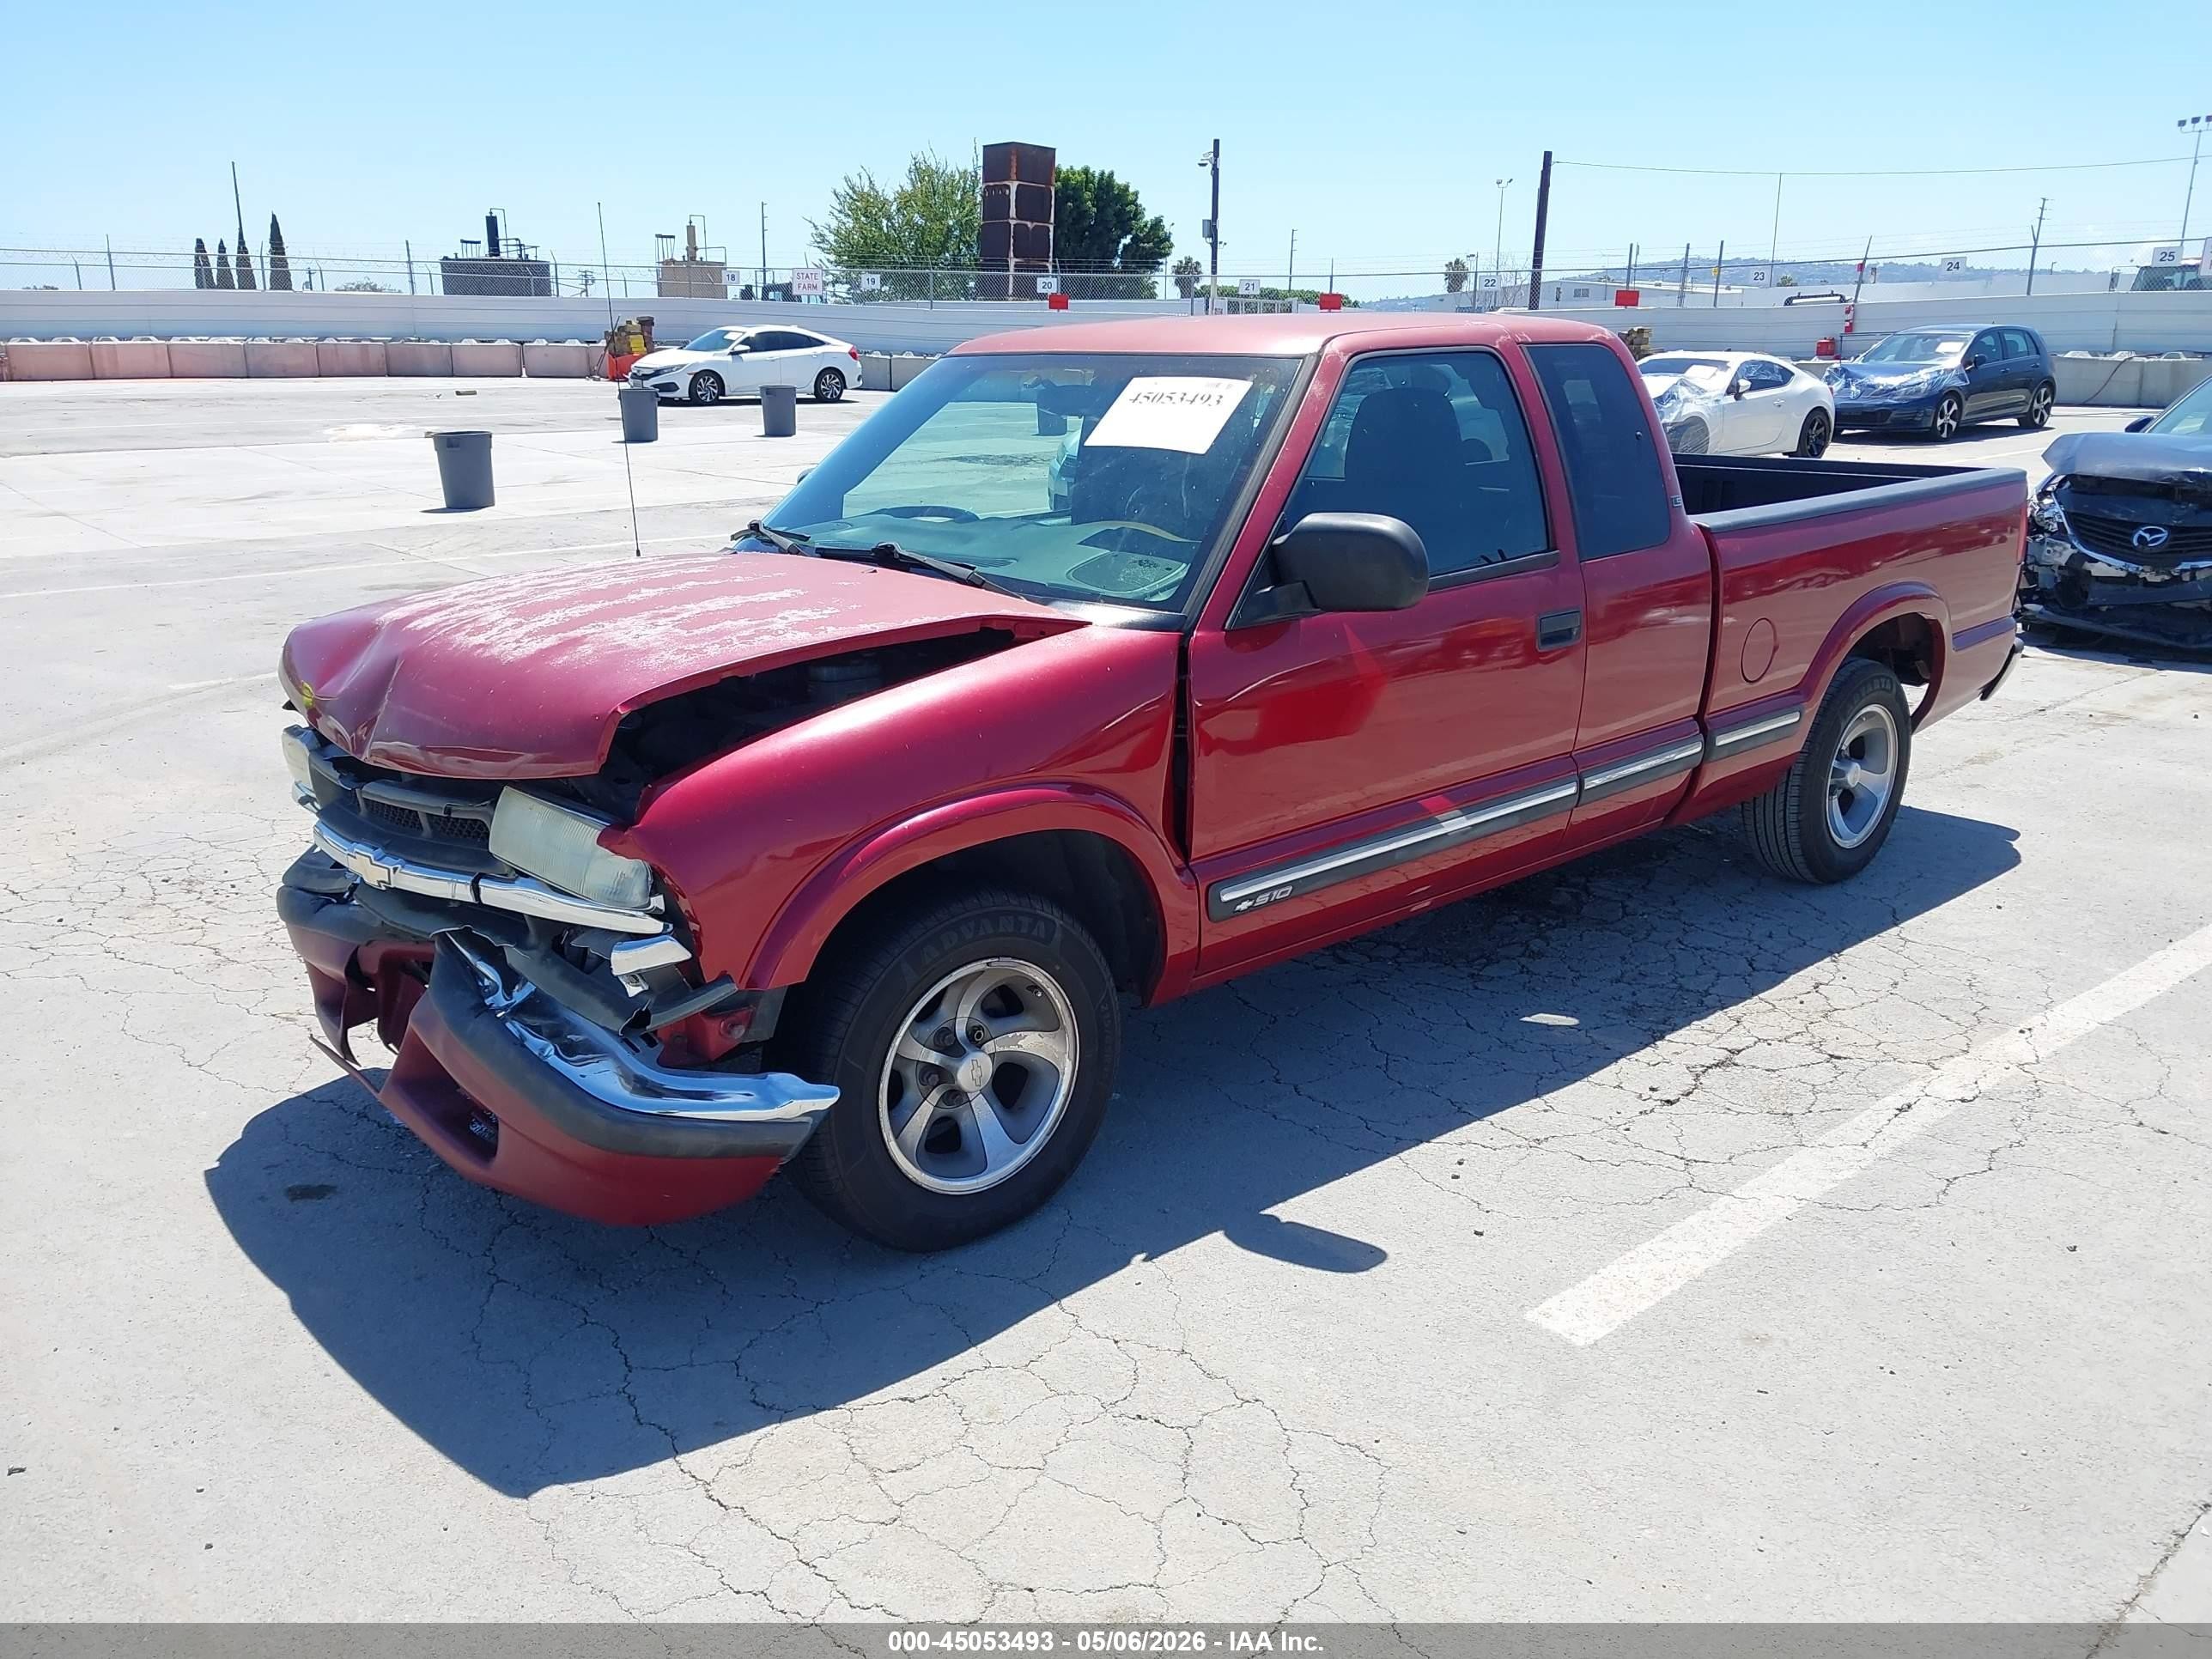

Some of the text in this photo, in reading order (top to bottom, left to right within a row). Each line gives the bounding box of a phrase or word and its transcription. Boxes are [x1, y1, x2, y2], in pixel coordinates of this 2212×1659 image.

[2159, 251, 2177, 262] 25
[1946, 261, 1960, 271] 24
[796, 272, 818, 281] STATE
[1753, 271, 1765, 281] 23
[866, 277, 876, 286] 19
[1042, 281, 1053, 289] 20
[1484, 278, 1497, 288] 22
[797, 283, 818, 291] FARM
[1244, 283, 1255, 291] 21
[1128, 392, 1224, 407] 45053493
[1254, 885, 1293, 907] S10
[921, 915, 1046, 963] ADVANTA
